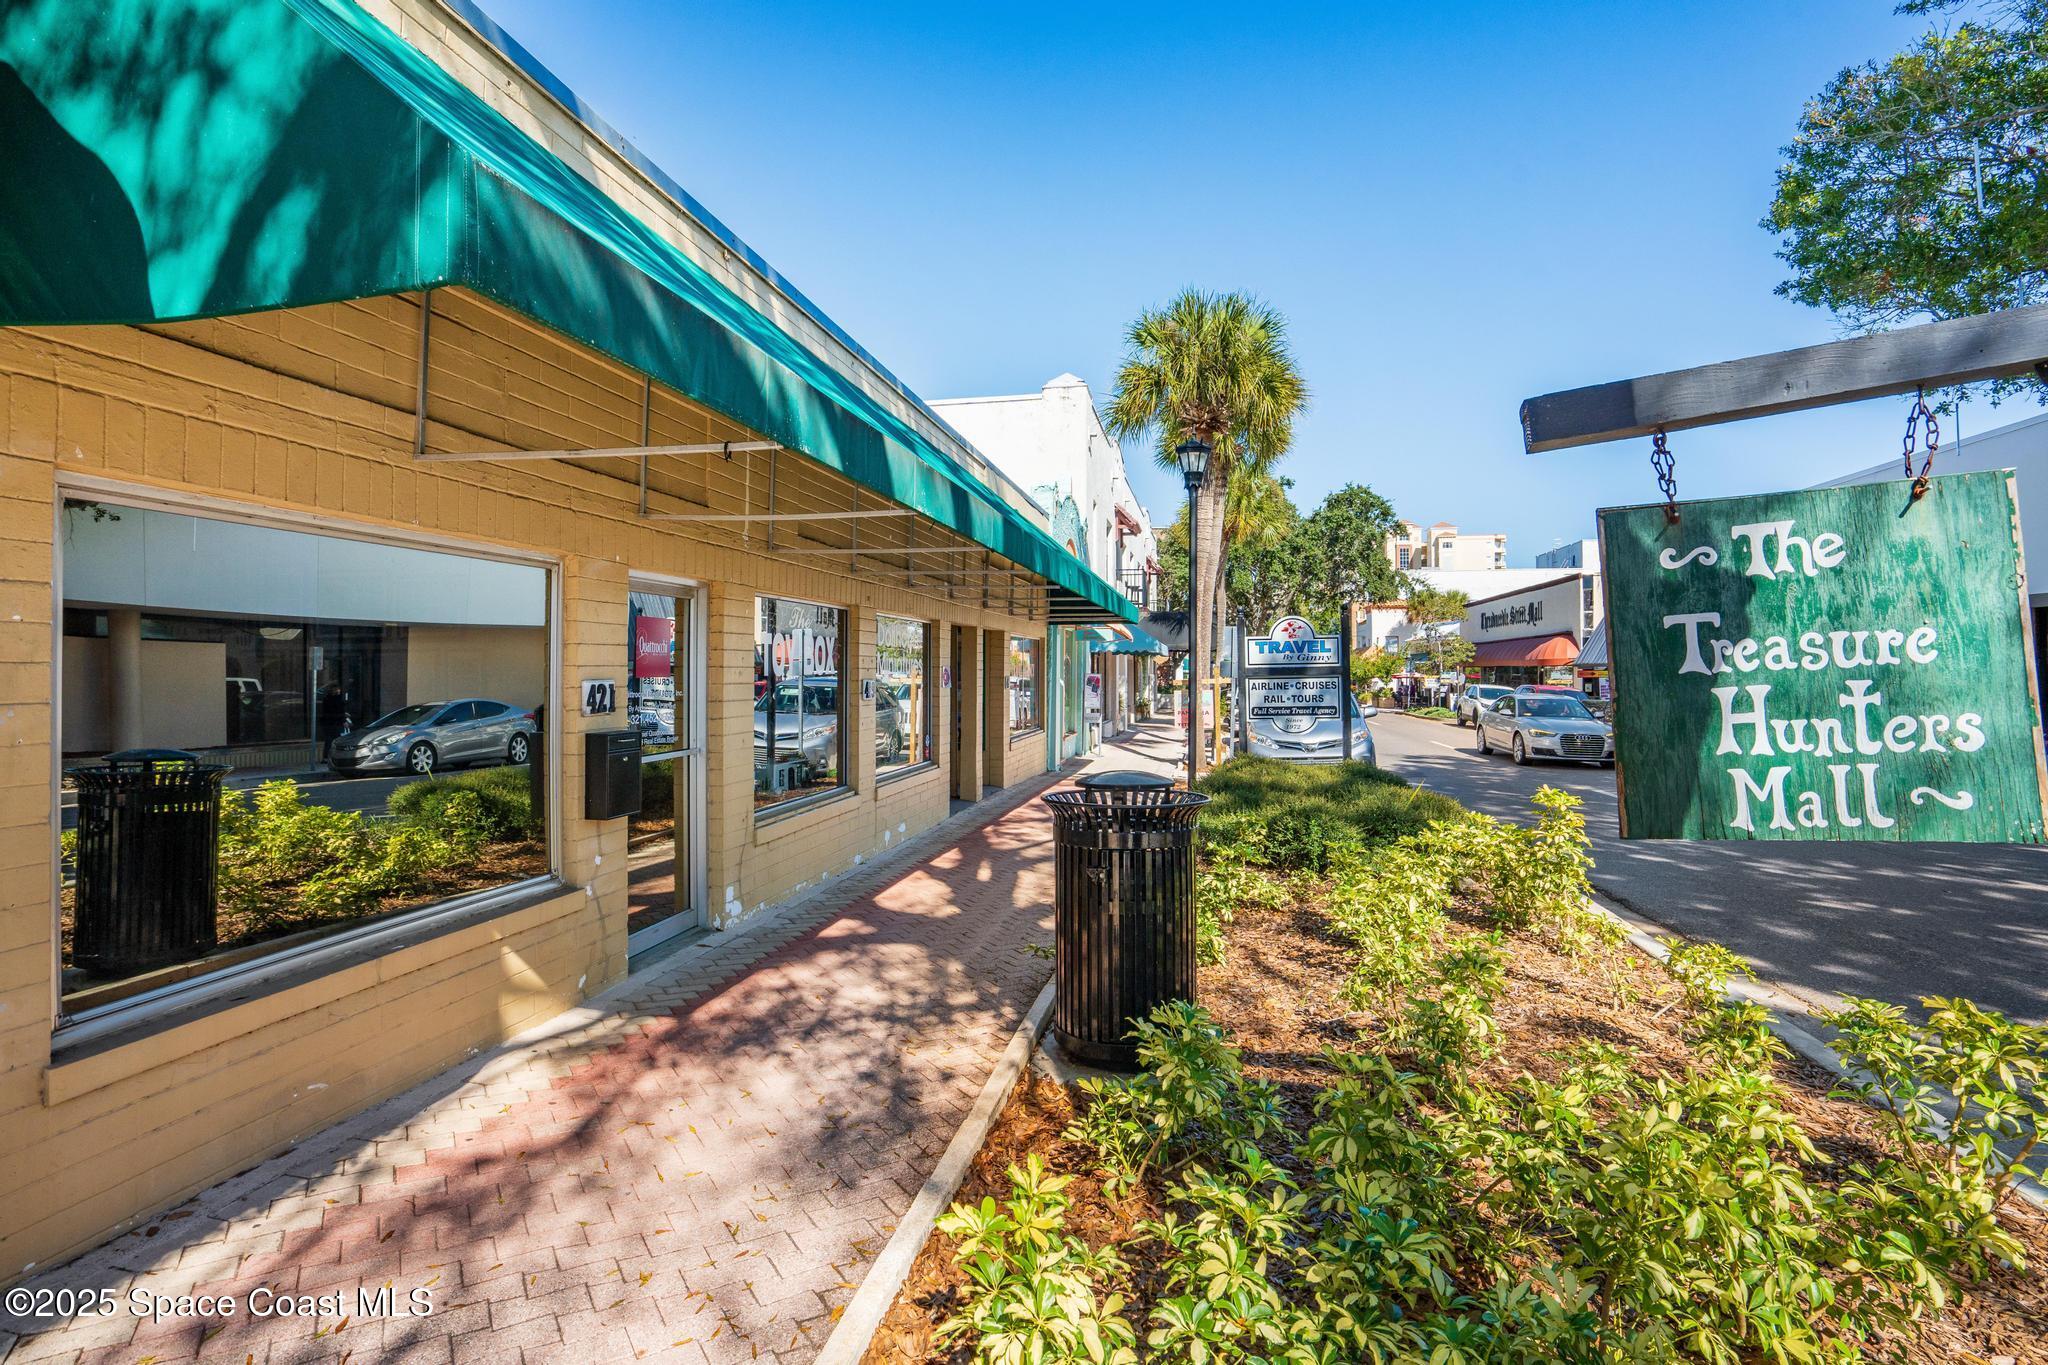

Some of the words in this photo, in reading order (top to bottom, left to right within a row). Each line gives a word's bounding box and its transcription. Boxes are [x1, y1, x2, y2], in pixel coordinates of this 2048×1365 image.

[1731, 520, 1846, 580] The
[789, 606, 812, 629] The
[1527, 601, 1543, 627] Mall
[803, 631, 836, 676] BOX
[1255, 640, 1331, 654] TRAVEL
[1663, 612, 1938, 676] Treasure
[1297, 653, 1332, 663] Ginny
[587, 684, 616, 714] 421
[1251, 682, 1289, 691] AIRLINE
[1295, 681, 1337, 690] CRUISES
[1263, 695, 1285, 703] RAIL
[1291, 694, 1324, 703] TOURS
[1268, 707, 1290, 715] Service
[1292, 707, 1312, 715] Travel
[1313, 706, 1336, 715] Agency
[1711, 679, 1986, 757] Hunters
[1727, 763, 1895, 832] Mall
